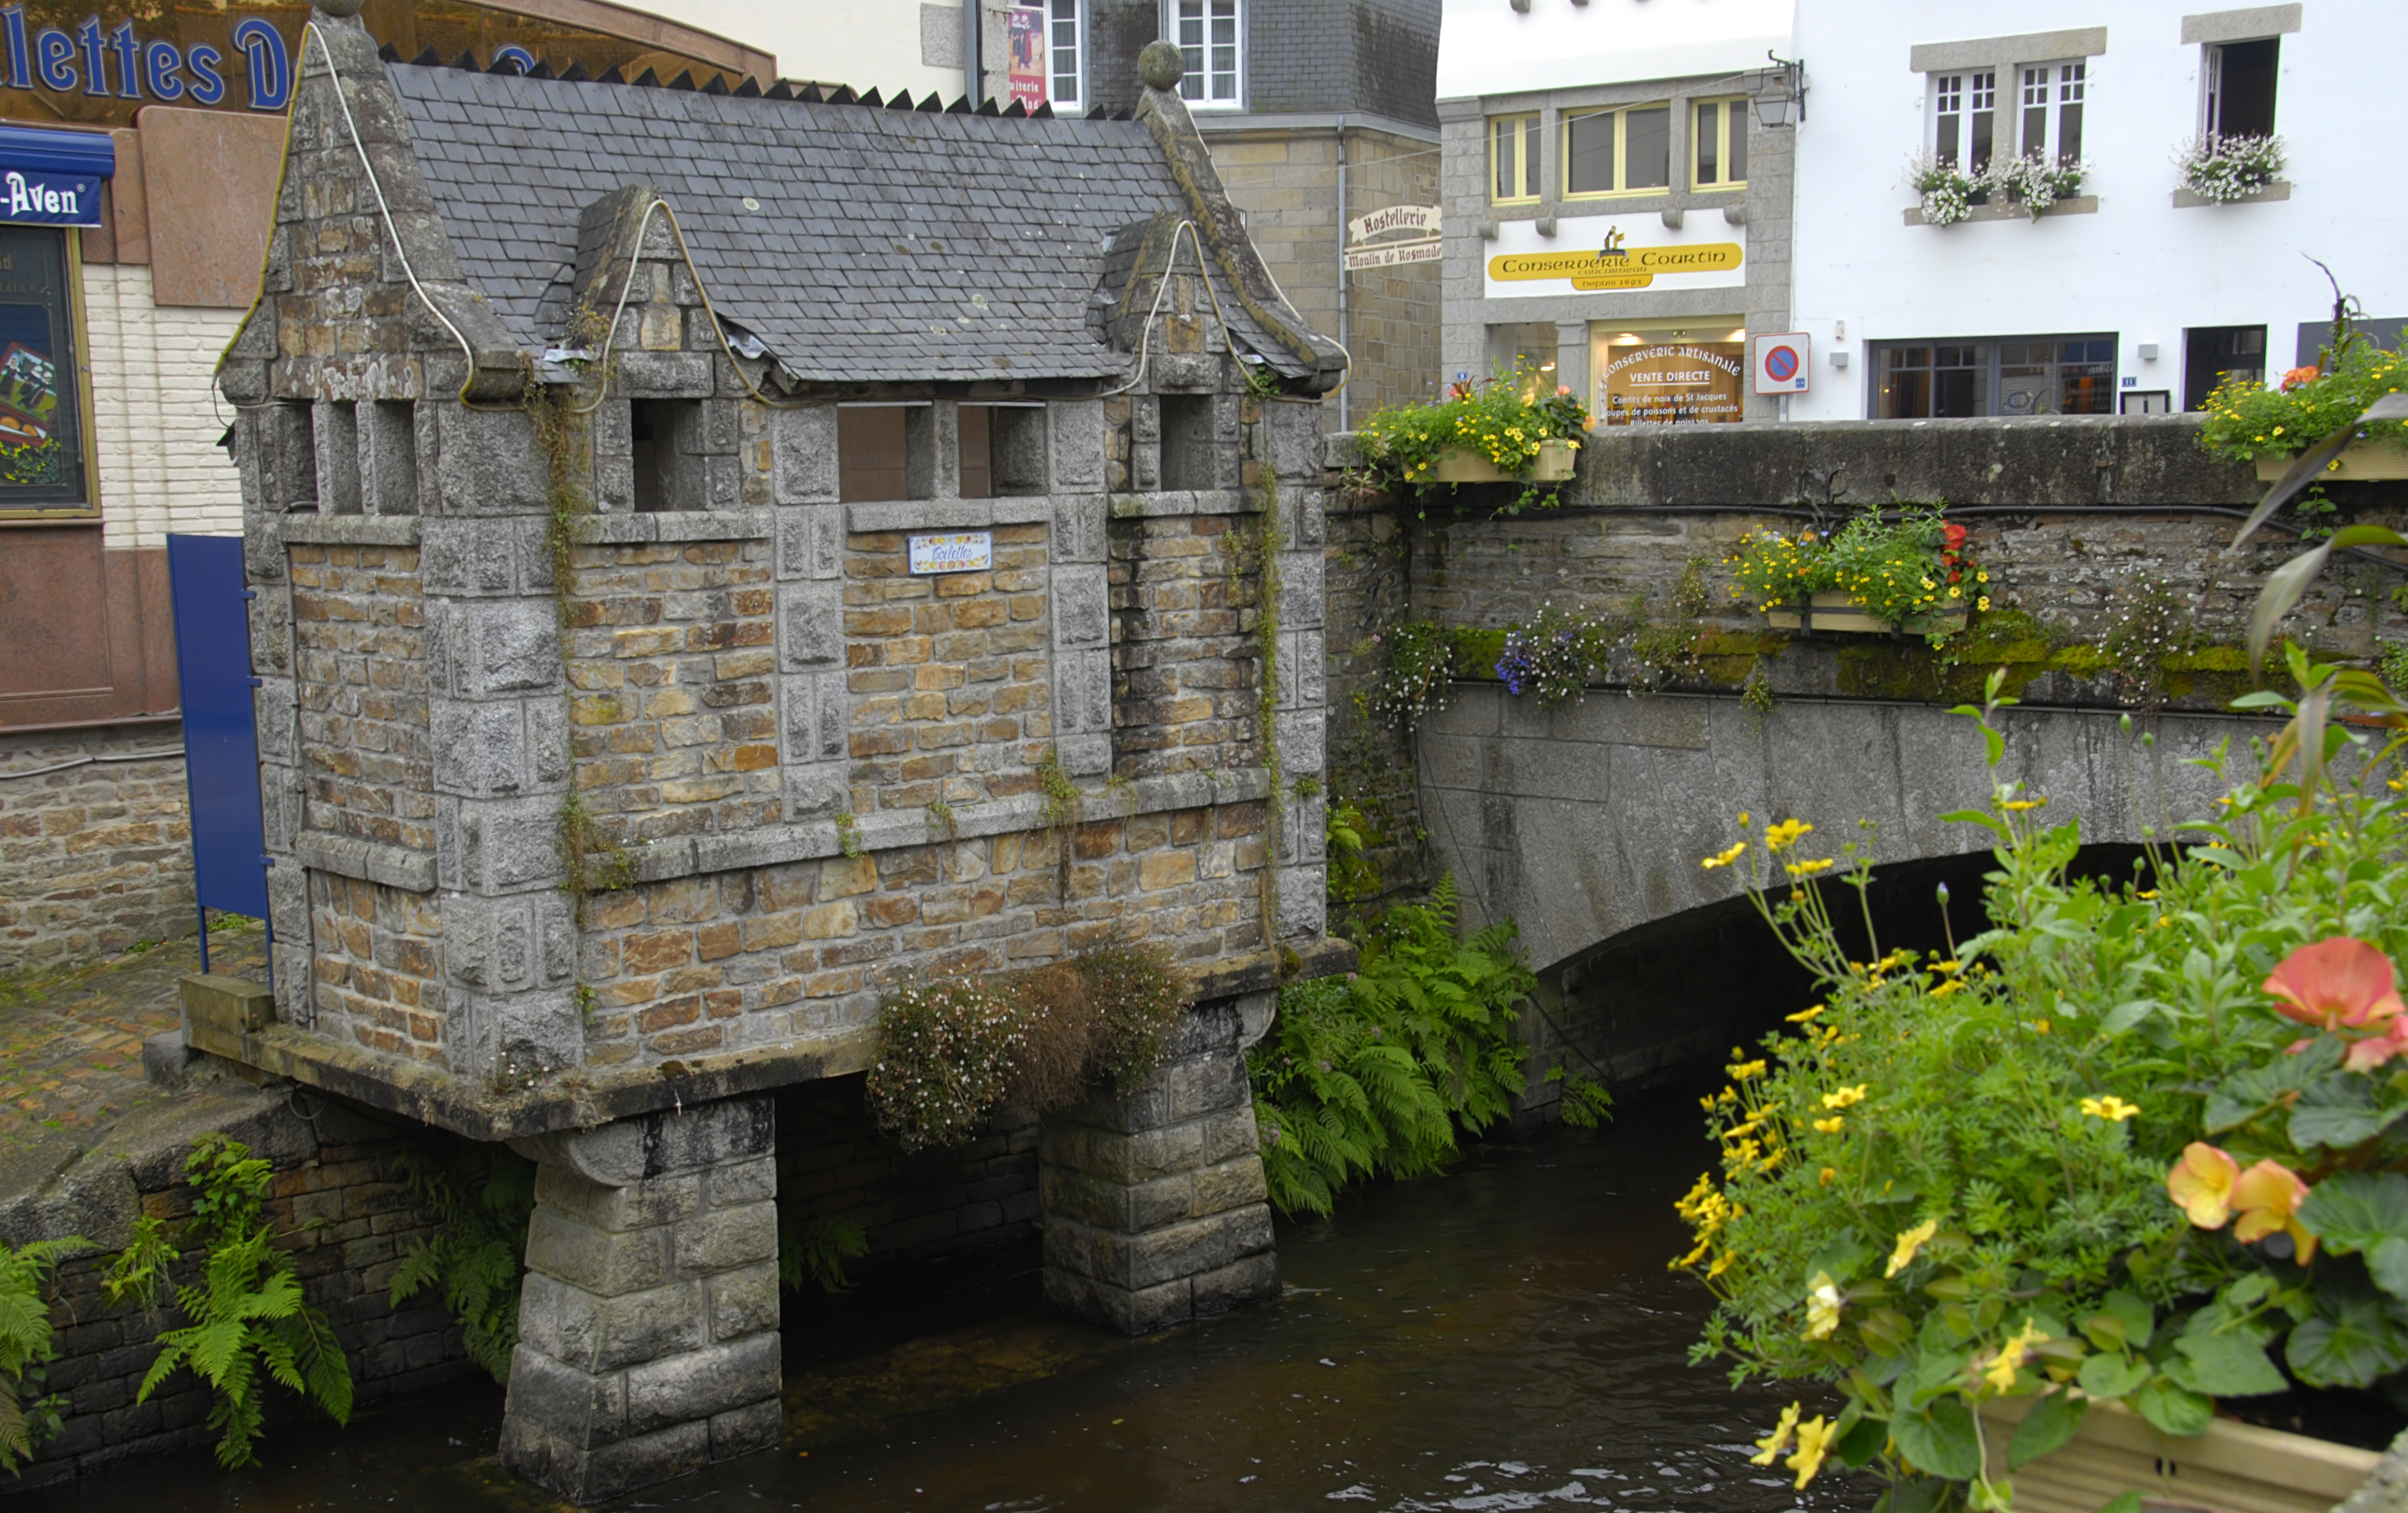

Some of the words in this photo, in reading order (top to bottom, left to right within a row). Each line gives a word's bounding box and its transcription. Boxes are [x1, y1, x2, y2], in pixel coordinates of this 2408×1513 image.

[1364, 207, 1426, 234] Hostellerie
[1349, 252, 1381, 267] Moulin
[1385, 251, 1394, 263] de
[1503, 256, 1629, 272] Conserverie
[1641, 251, 1726, 266] Courtin
[1630, 372, 1663, 382] VENTE
[1667, 371, 1710, 381] DIRECTE
[1613, 396, 1640, 404] Confits
[1642, 394, 1652, 402] de
[1674, 393, 1683, 402] de
[1697, 393, 1726, 402] Jacques
[1643, 407, 1676, 417] poissons
[1689, 405, 1698, 414] de
[1702, 404, 1738, 413] crustacés
[932, 545, 972, 560] Toilettes
